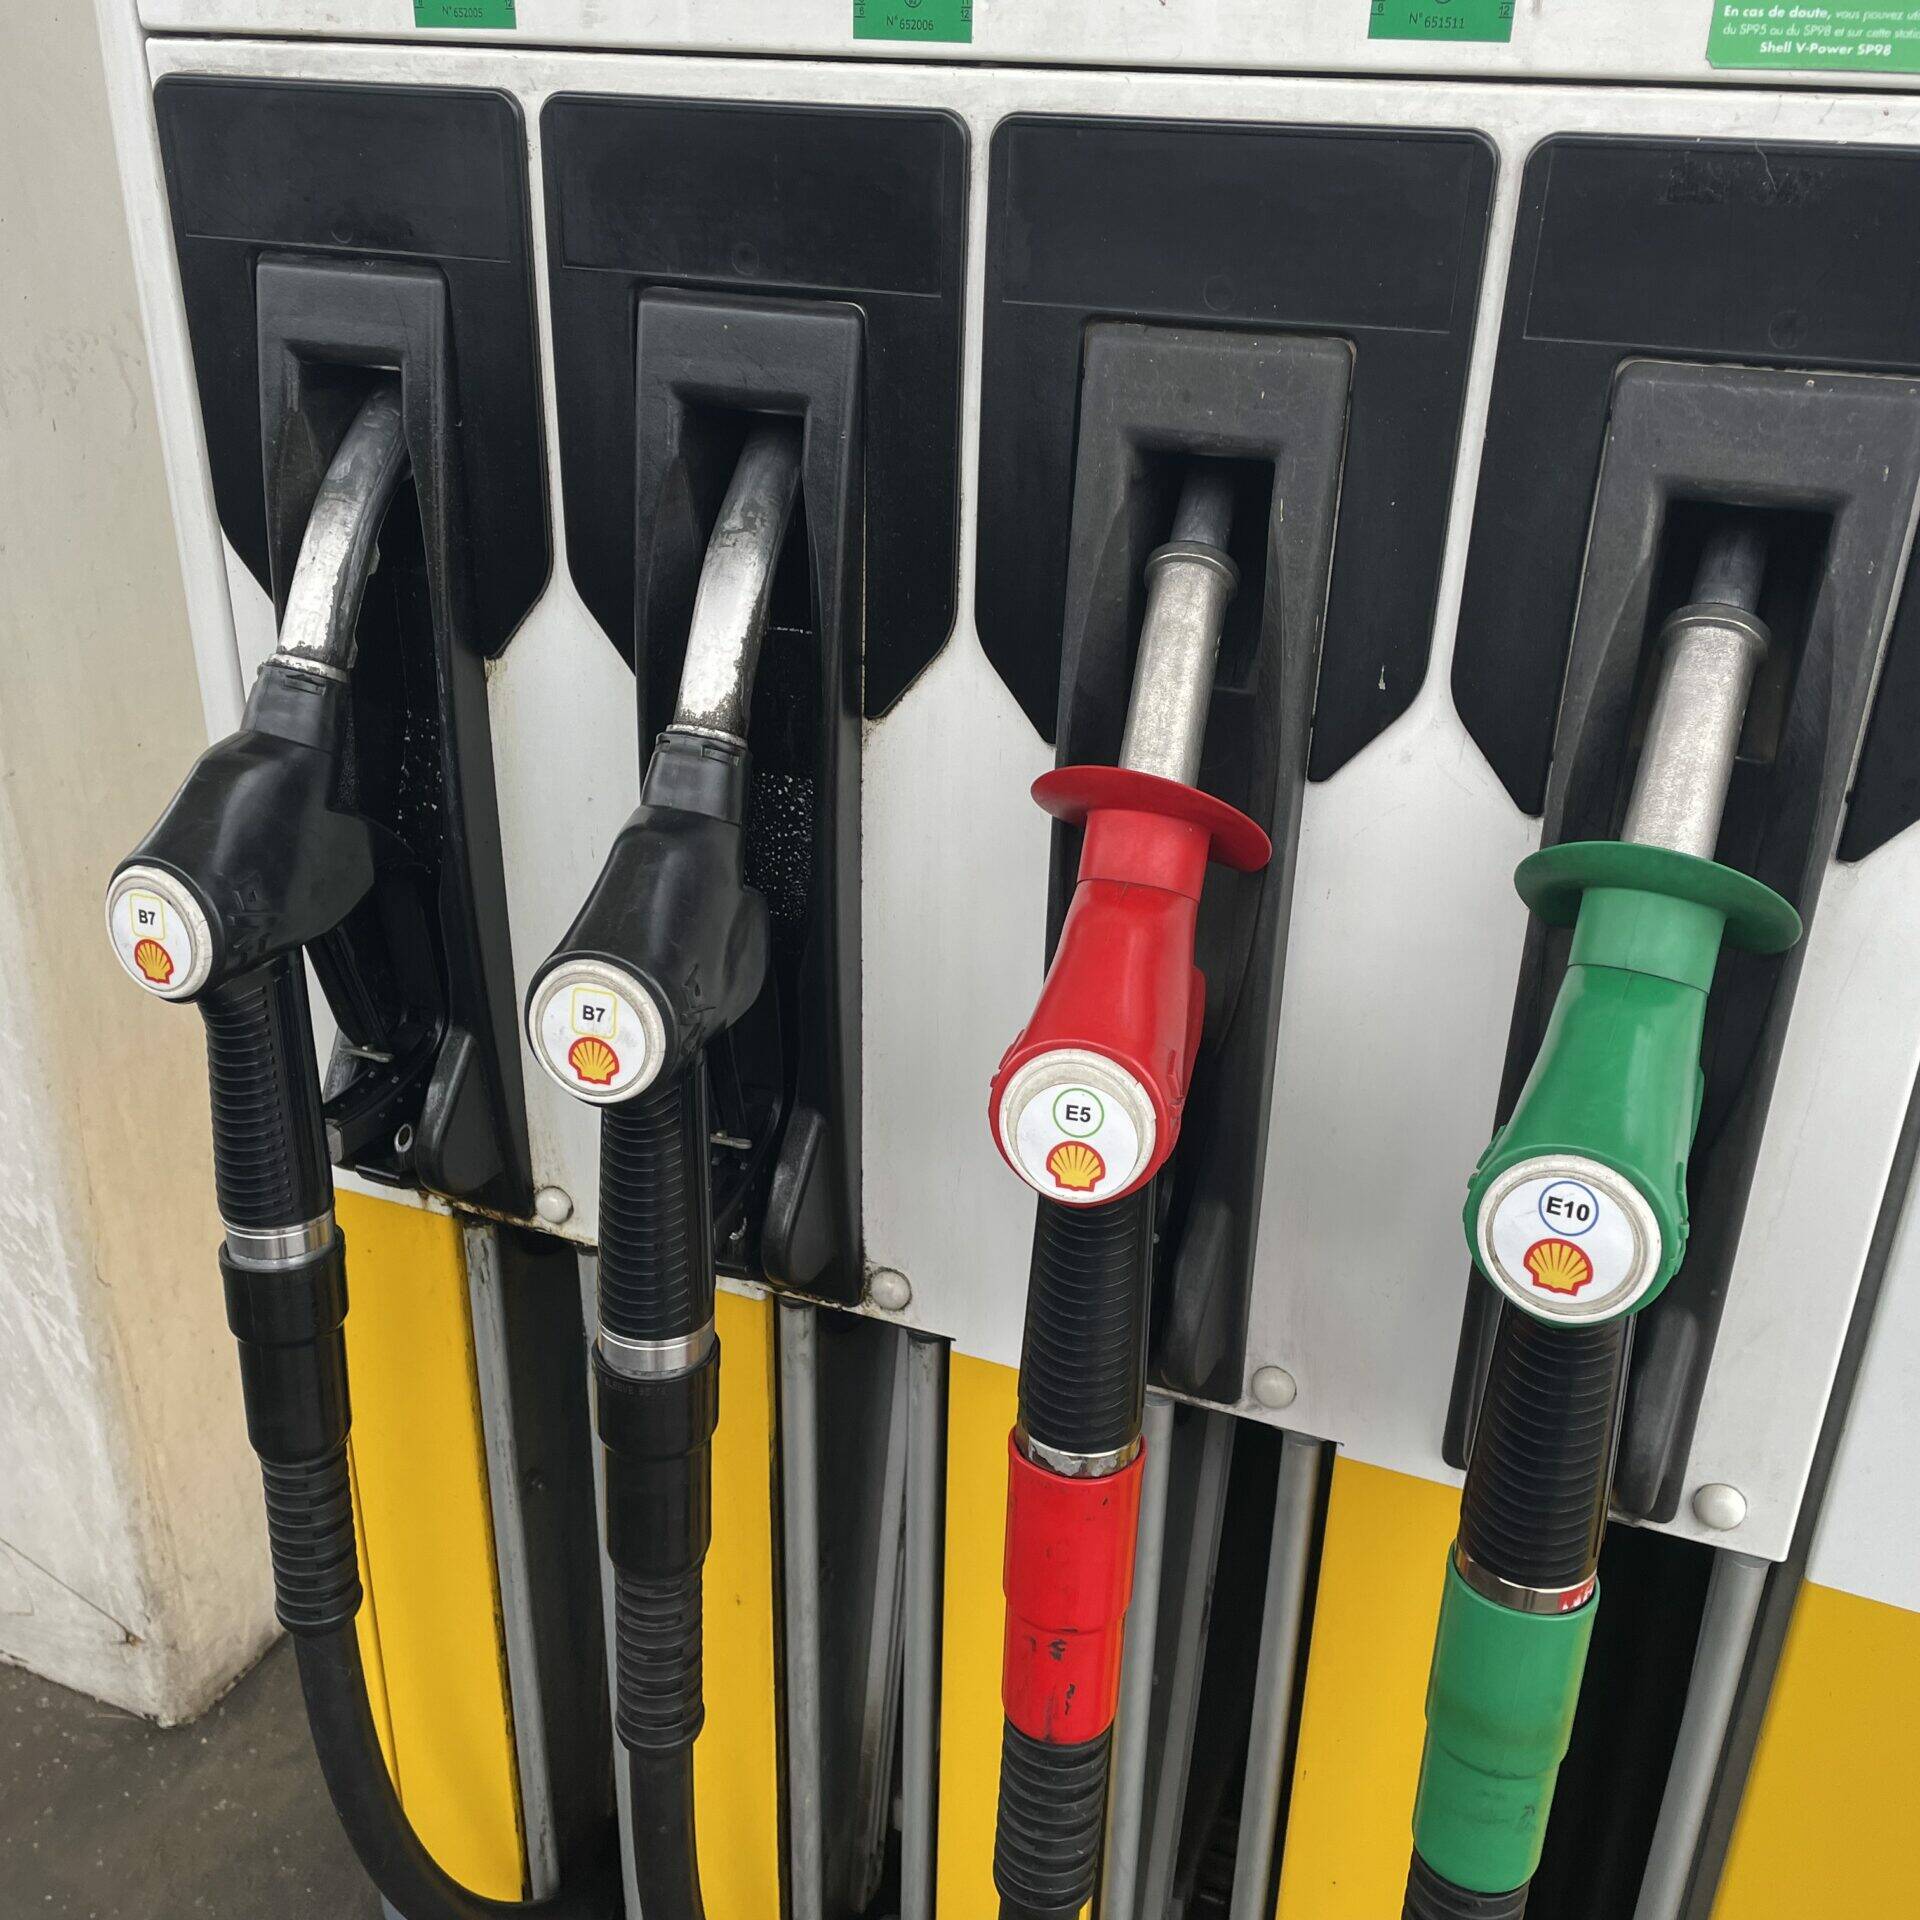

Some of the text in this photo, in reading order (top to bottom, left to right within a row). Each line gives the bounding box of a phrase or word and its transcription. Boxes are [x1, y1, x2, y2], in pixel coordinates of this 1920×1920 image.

[453, 7, 483, 18] 652005
[960, 9, 970, 19] 12
[1499, 5, 1510, 16] 12
[1723, 5, 1739, 17] En
[1743, 8, 1764, 17] cas
[1768, 5, 1785, 18] de
[1789, 6, 1831, 20] doute,
[1835, 10, 1860, 19] vous
[1862, 11, 1904, 22] pouvez
[899, 19, 934, 30] 652006
[1424, 16, 1464, 29] 651511
[1722, 22, 1737, 35] du
[1739, 23, 1767, 35] SP95
[1769, 27, 1783, 36] ou
[1786, 23, 1800, 36] du
[1803, 24, 1832, 37] SP98
[1833, 27, 1845, 37] et
[1847, 29, 1863, 37] sur
[1866, 28, 1892, 38] cette
[1759, 41, 1892, 57] Shell V-Power SP98
[138, 909, 155, 926] B7
[582, 1005, 605, 1022] B7
[1065, 1104, 1091, 1123] E5
[1545, 1196, 1590, 1222] E10
